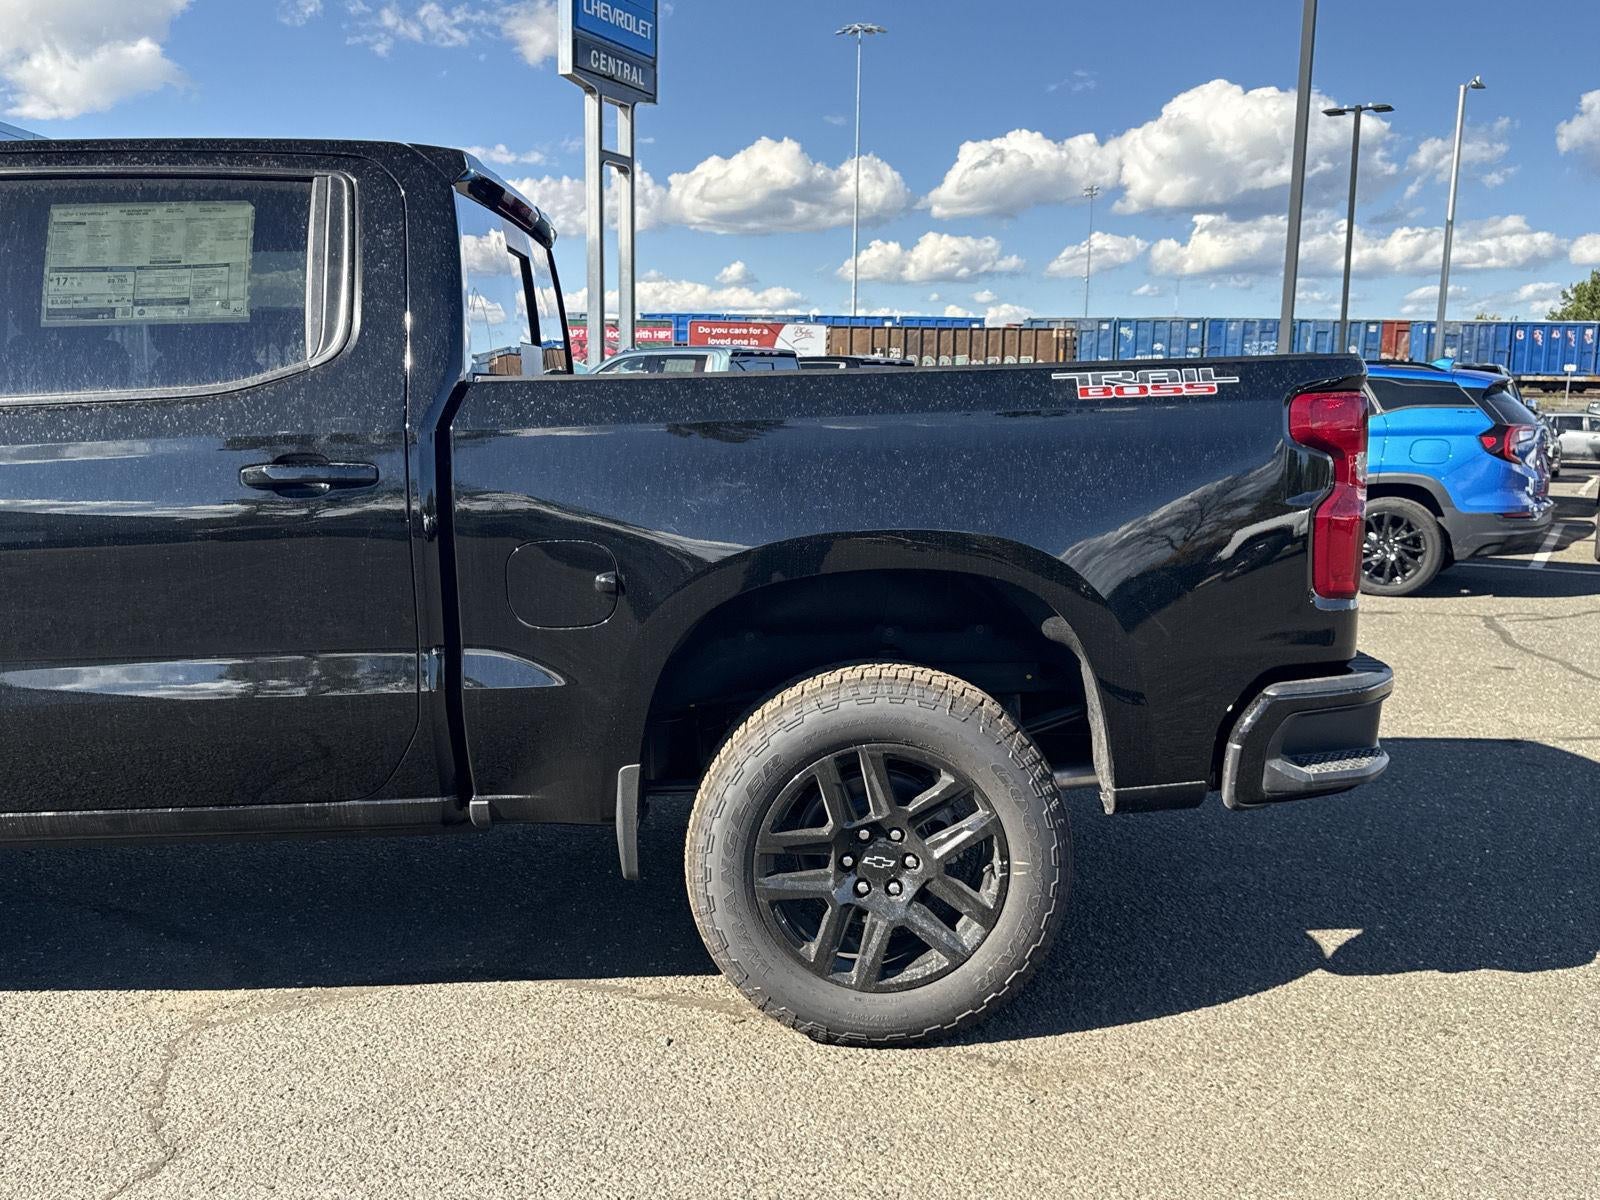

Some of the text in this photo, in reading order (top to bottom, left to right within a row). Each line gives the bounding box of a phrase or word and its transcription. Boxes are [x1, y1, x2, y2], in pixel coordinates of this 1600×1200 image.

[583, 0, 653, 40] CHEVROLET
[590, 49, 645, 86] CENTRAL
[55, 276, 69, 286] 17
[568, 328, 585, 338] AP?
[606, 329, 620, 338] loc
[698, 326, 711, 334] Do
[712, 327, 728, 335] you
[749, 326, 761, 335] for
[707, 337, 759, 346] loved one in
[1051, 367, 1240, 387] TRAIL
[1078, 381, 1219, 400] BOSS
[720, 752, 787, 980] WRANGLER
[975, 762, 1047, 993] GOODYEAR
